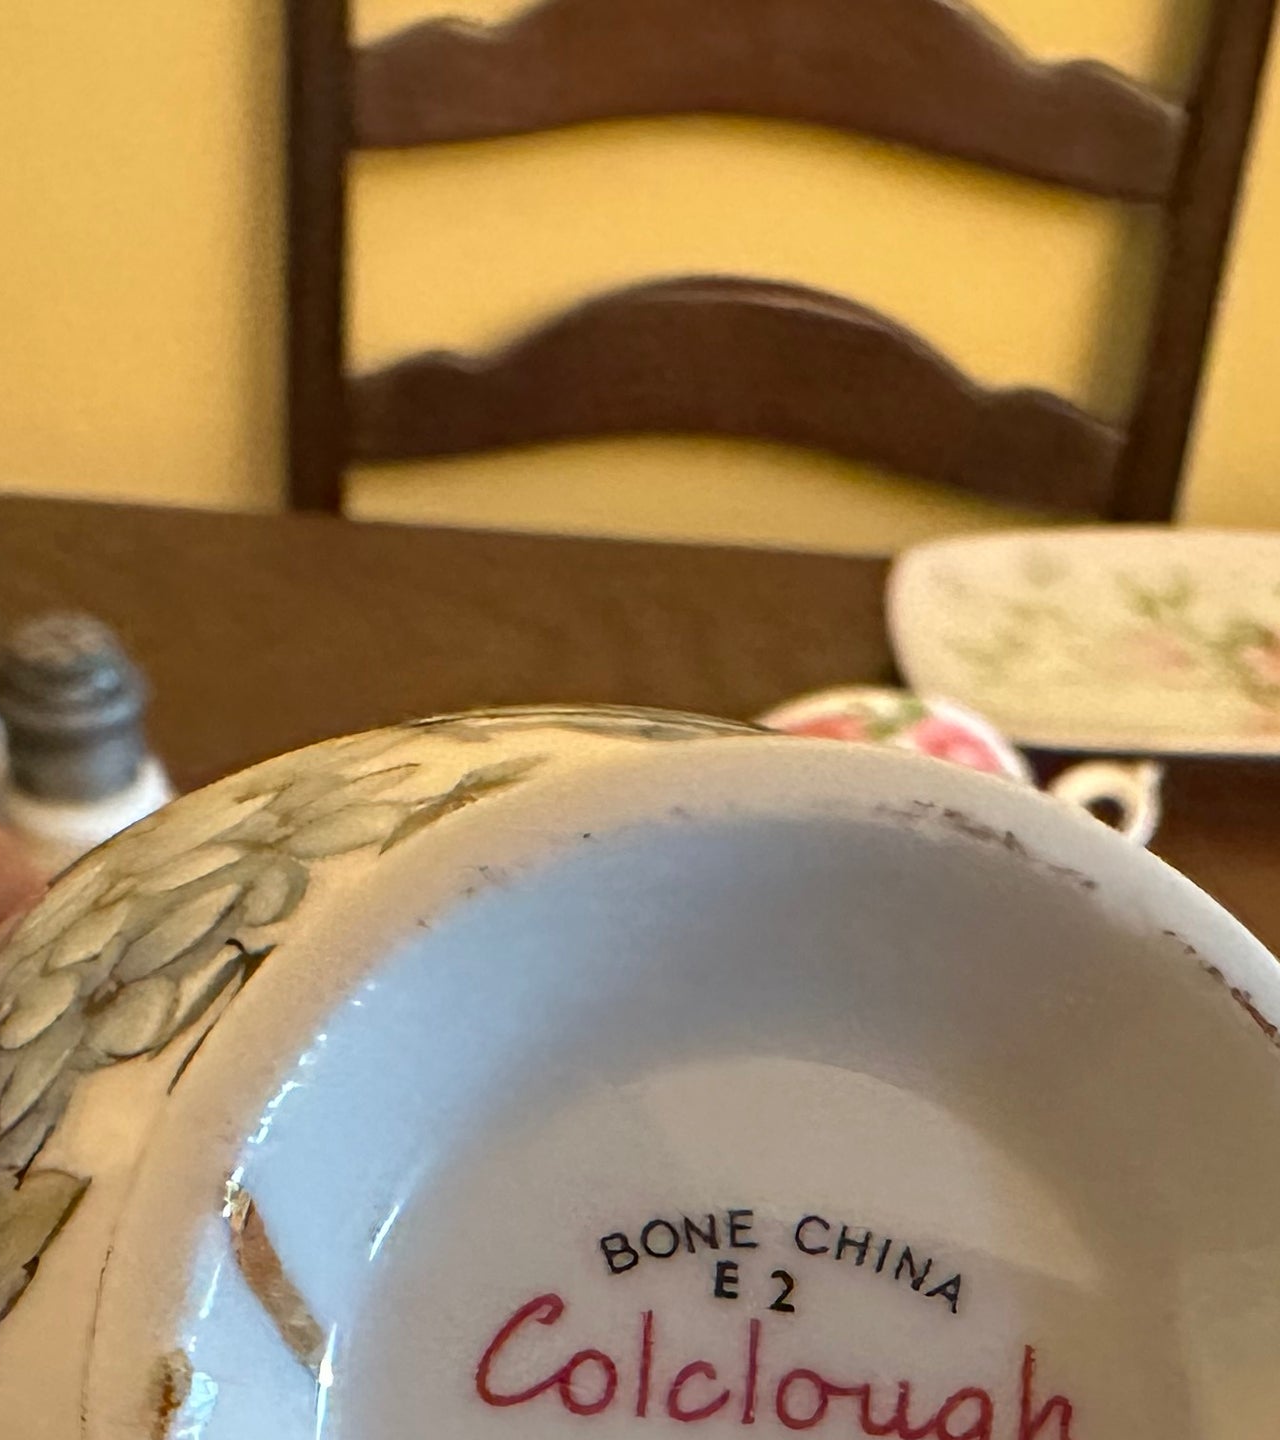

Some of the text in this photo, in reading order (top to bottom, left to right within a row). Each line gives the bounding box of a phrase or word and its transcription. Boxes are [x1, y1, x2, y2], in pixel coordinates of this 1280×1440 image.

[599, 1209, 963, 1315] BONE CHINA
[713, 1260, 797, 1314] E 2
